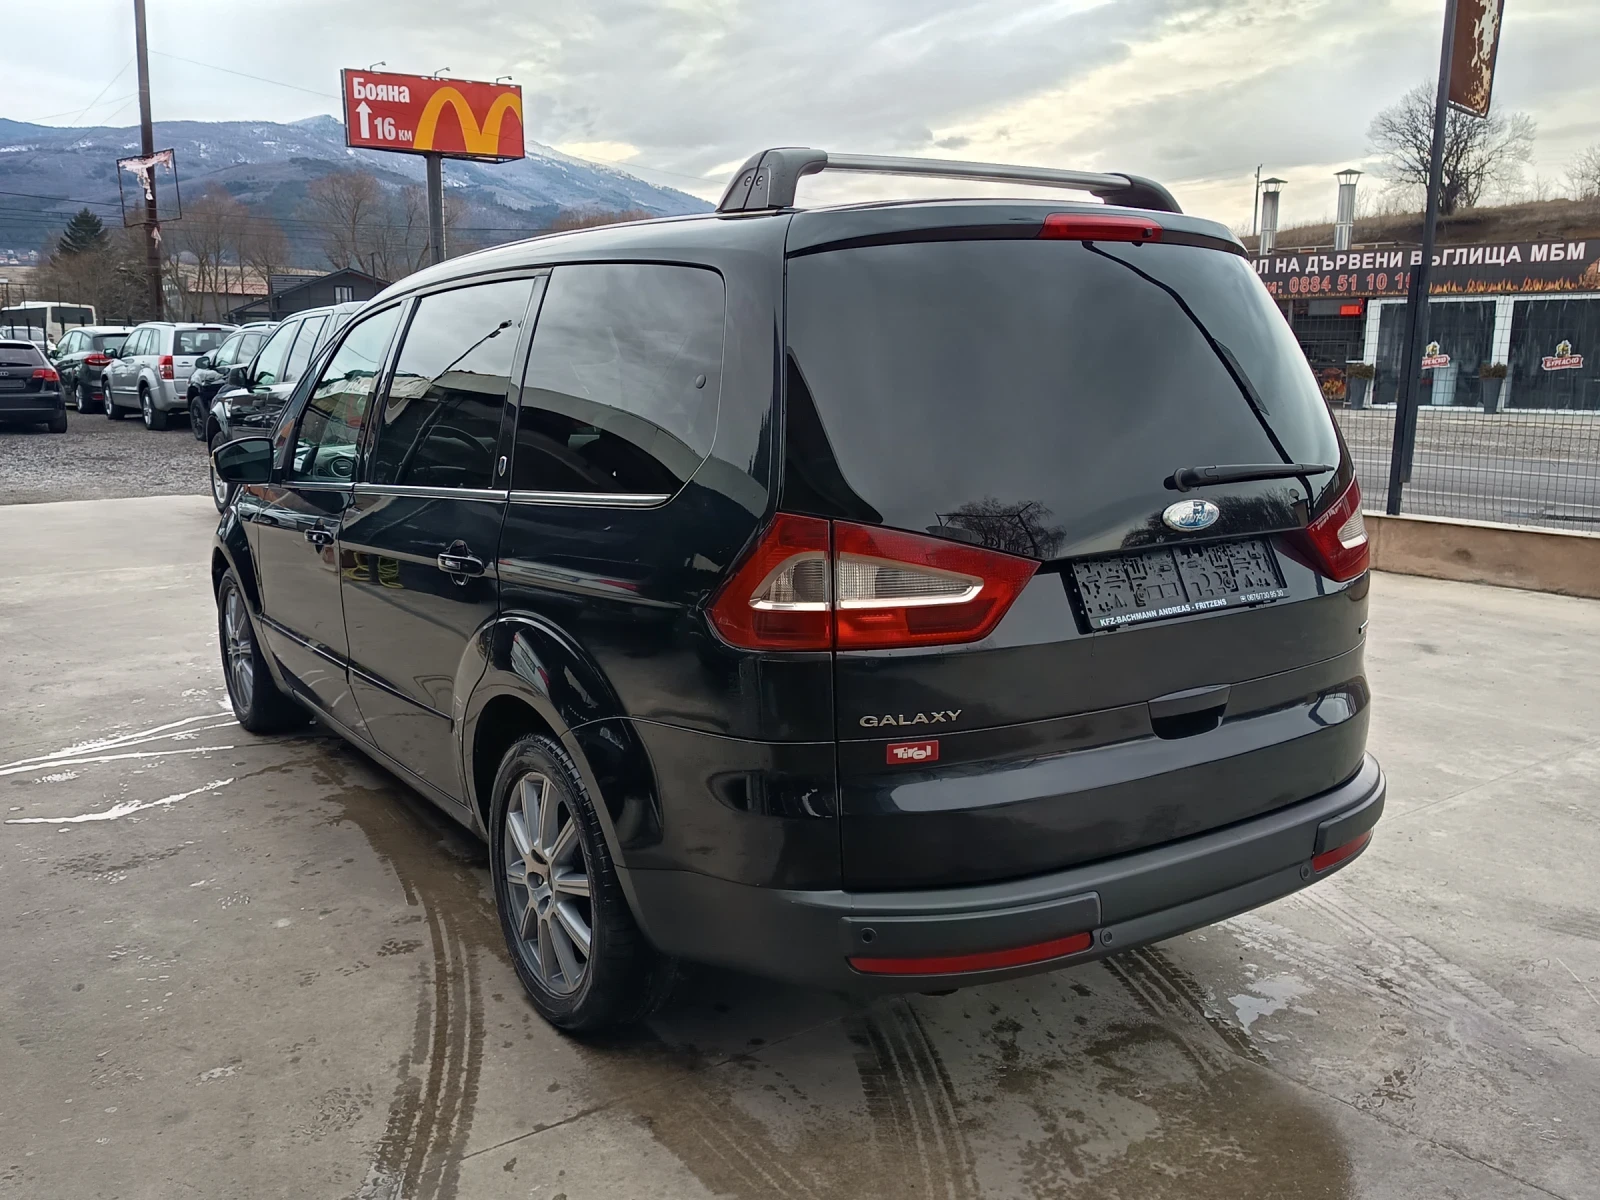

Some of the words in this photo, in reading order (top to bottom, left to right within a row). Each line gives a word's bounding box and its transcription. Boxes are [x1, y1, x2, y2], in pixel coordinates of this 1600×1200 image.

[353, 77, 410, 103] Бояна
[374, 117, 396, 140] 16
[1276, 257, 1300, 273] НА
[1306, 252, 1403, 274] ДЪРВЕНИ
[1530, 242, 1585, 262] МБМ
[1289, 275, 1331, 293] 0884
[1337, 274, 1357, 291] 51
[1366, 273, 1388, 290] 10
[1178, 509, 1209, 524] Ford
[1100, 610, 1157, 625] KFZ-BACHMANN
[1158, 604, 1190, 615] ANDREAS
[1195, 599, 1227, 610] FRITZENS
[859, 709, 962, 727] GALAXY
[893, 745, 931, 760] Tirol
